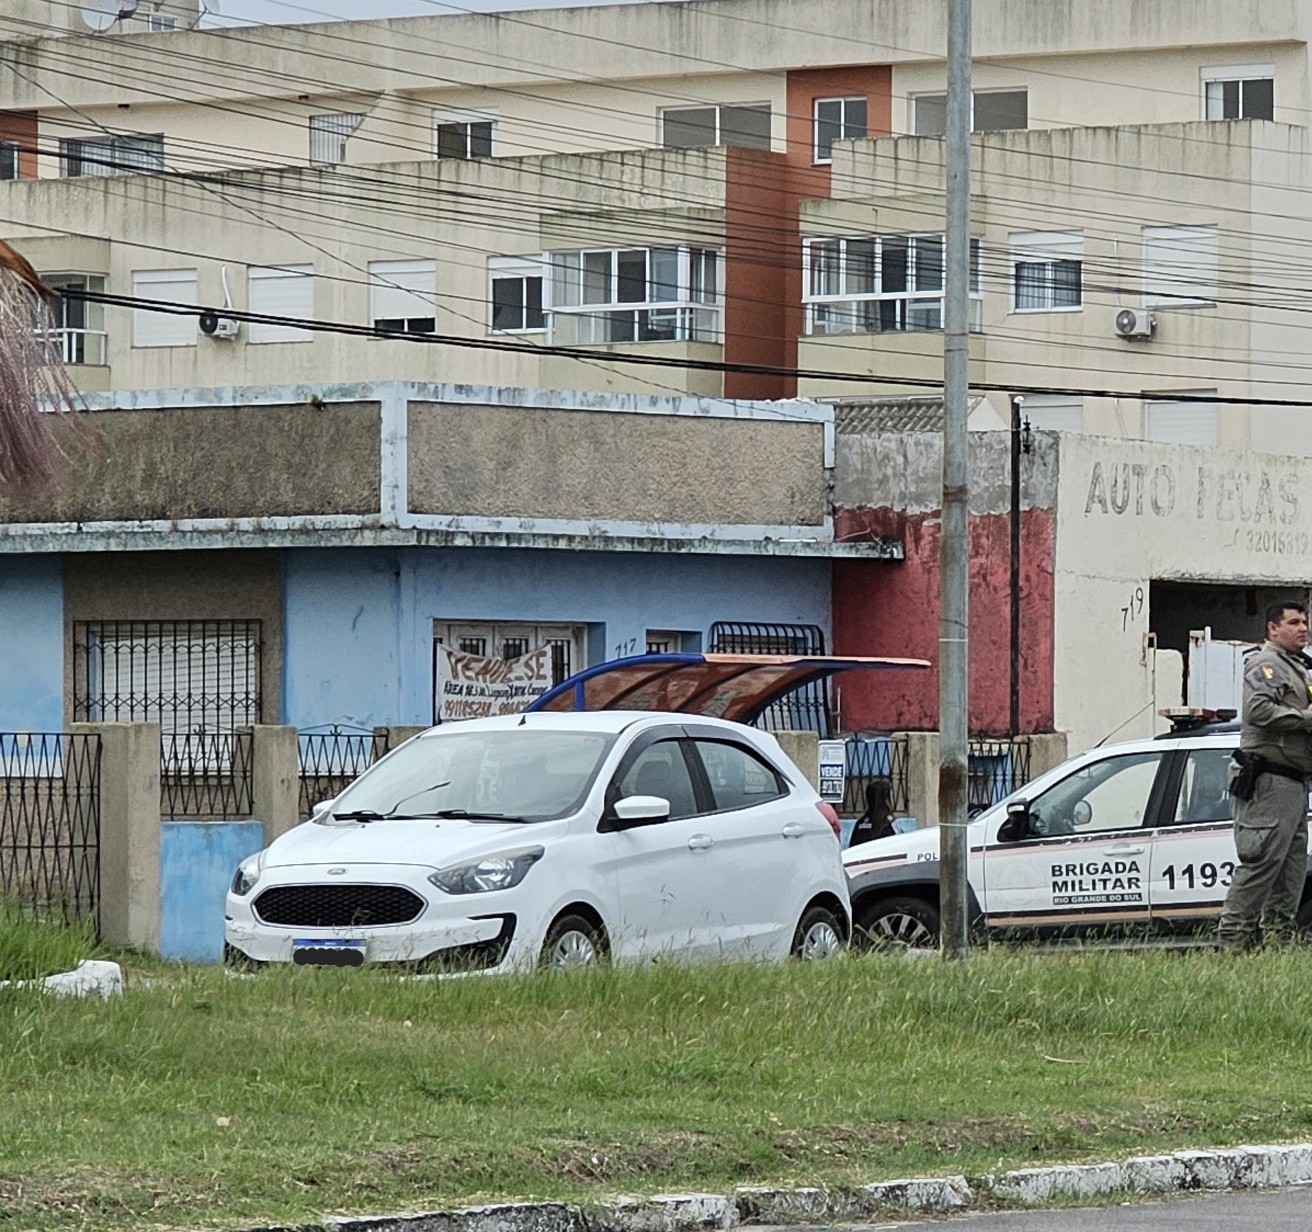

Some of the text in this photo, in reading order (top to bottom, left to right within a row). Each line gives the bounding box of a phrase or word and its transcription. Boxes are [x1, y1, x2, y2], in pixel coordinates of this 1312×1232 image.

[1084, 461, 1176, 518] AUTO
[1121, 587, 1144, 632] 719
[1051, 860, 1141, 878] BRIGADA
[1161, 861, 1236, 890] 1193
[1052, 877, 1141, 893] MILITAR
[1054, 893, 1141, 904] RIO GRANDE DO SUL
